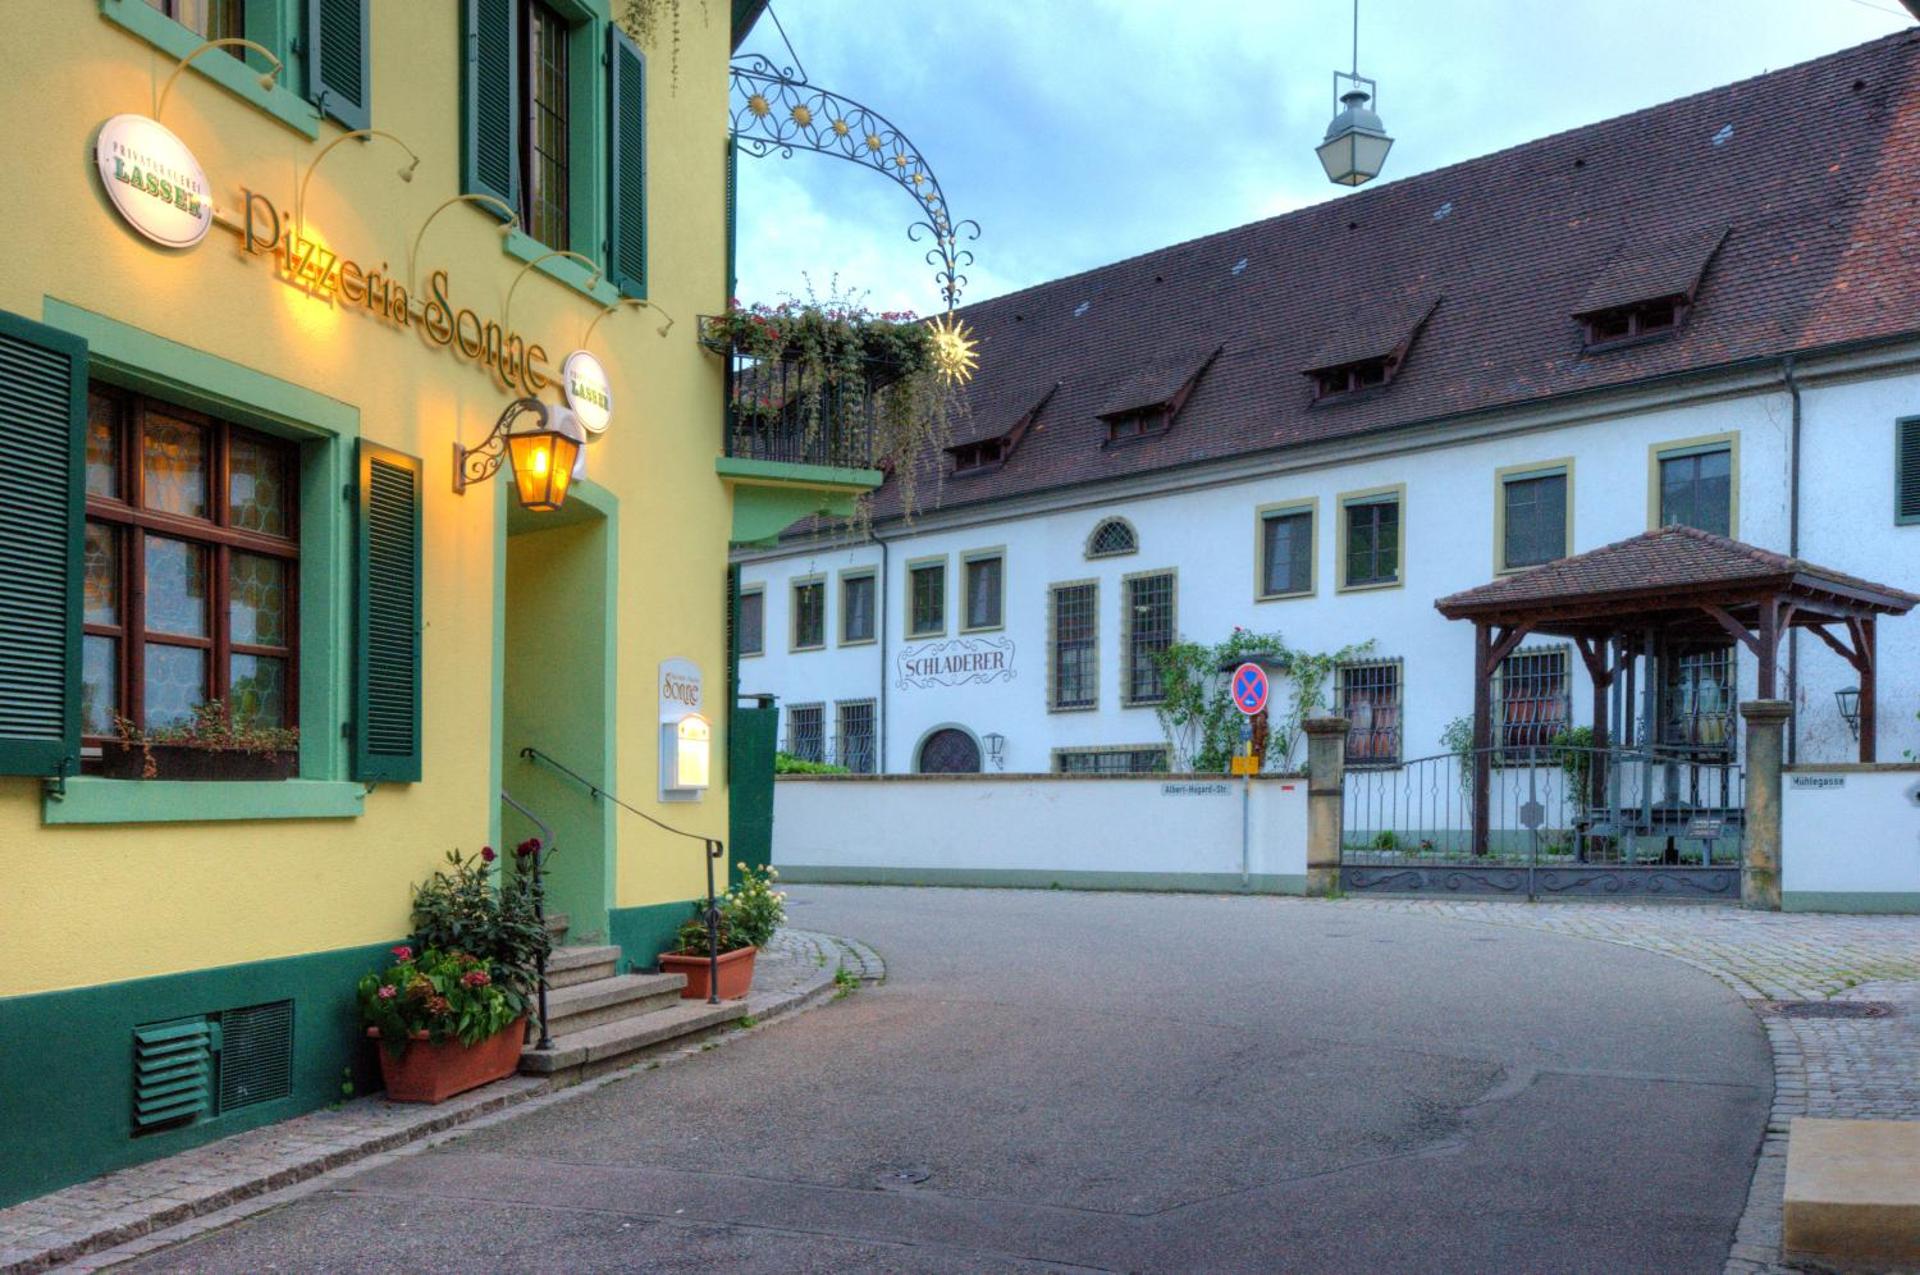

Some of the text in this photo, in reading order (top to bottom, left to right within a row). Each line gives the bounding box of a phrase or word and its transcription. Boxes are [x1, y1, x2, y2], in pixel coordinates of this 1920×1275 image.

[114, 156, 202, 220] LASSER
[240, 186, 550, 397] Pizzeria Sonne
[905, 651, 1004, 677] SCHLADERER
[663, 672, 699, 706] Sonne
